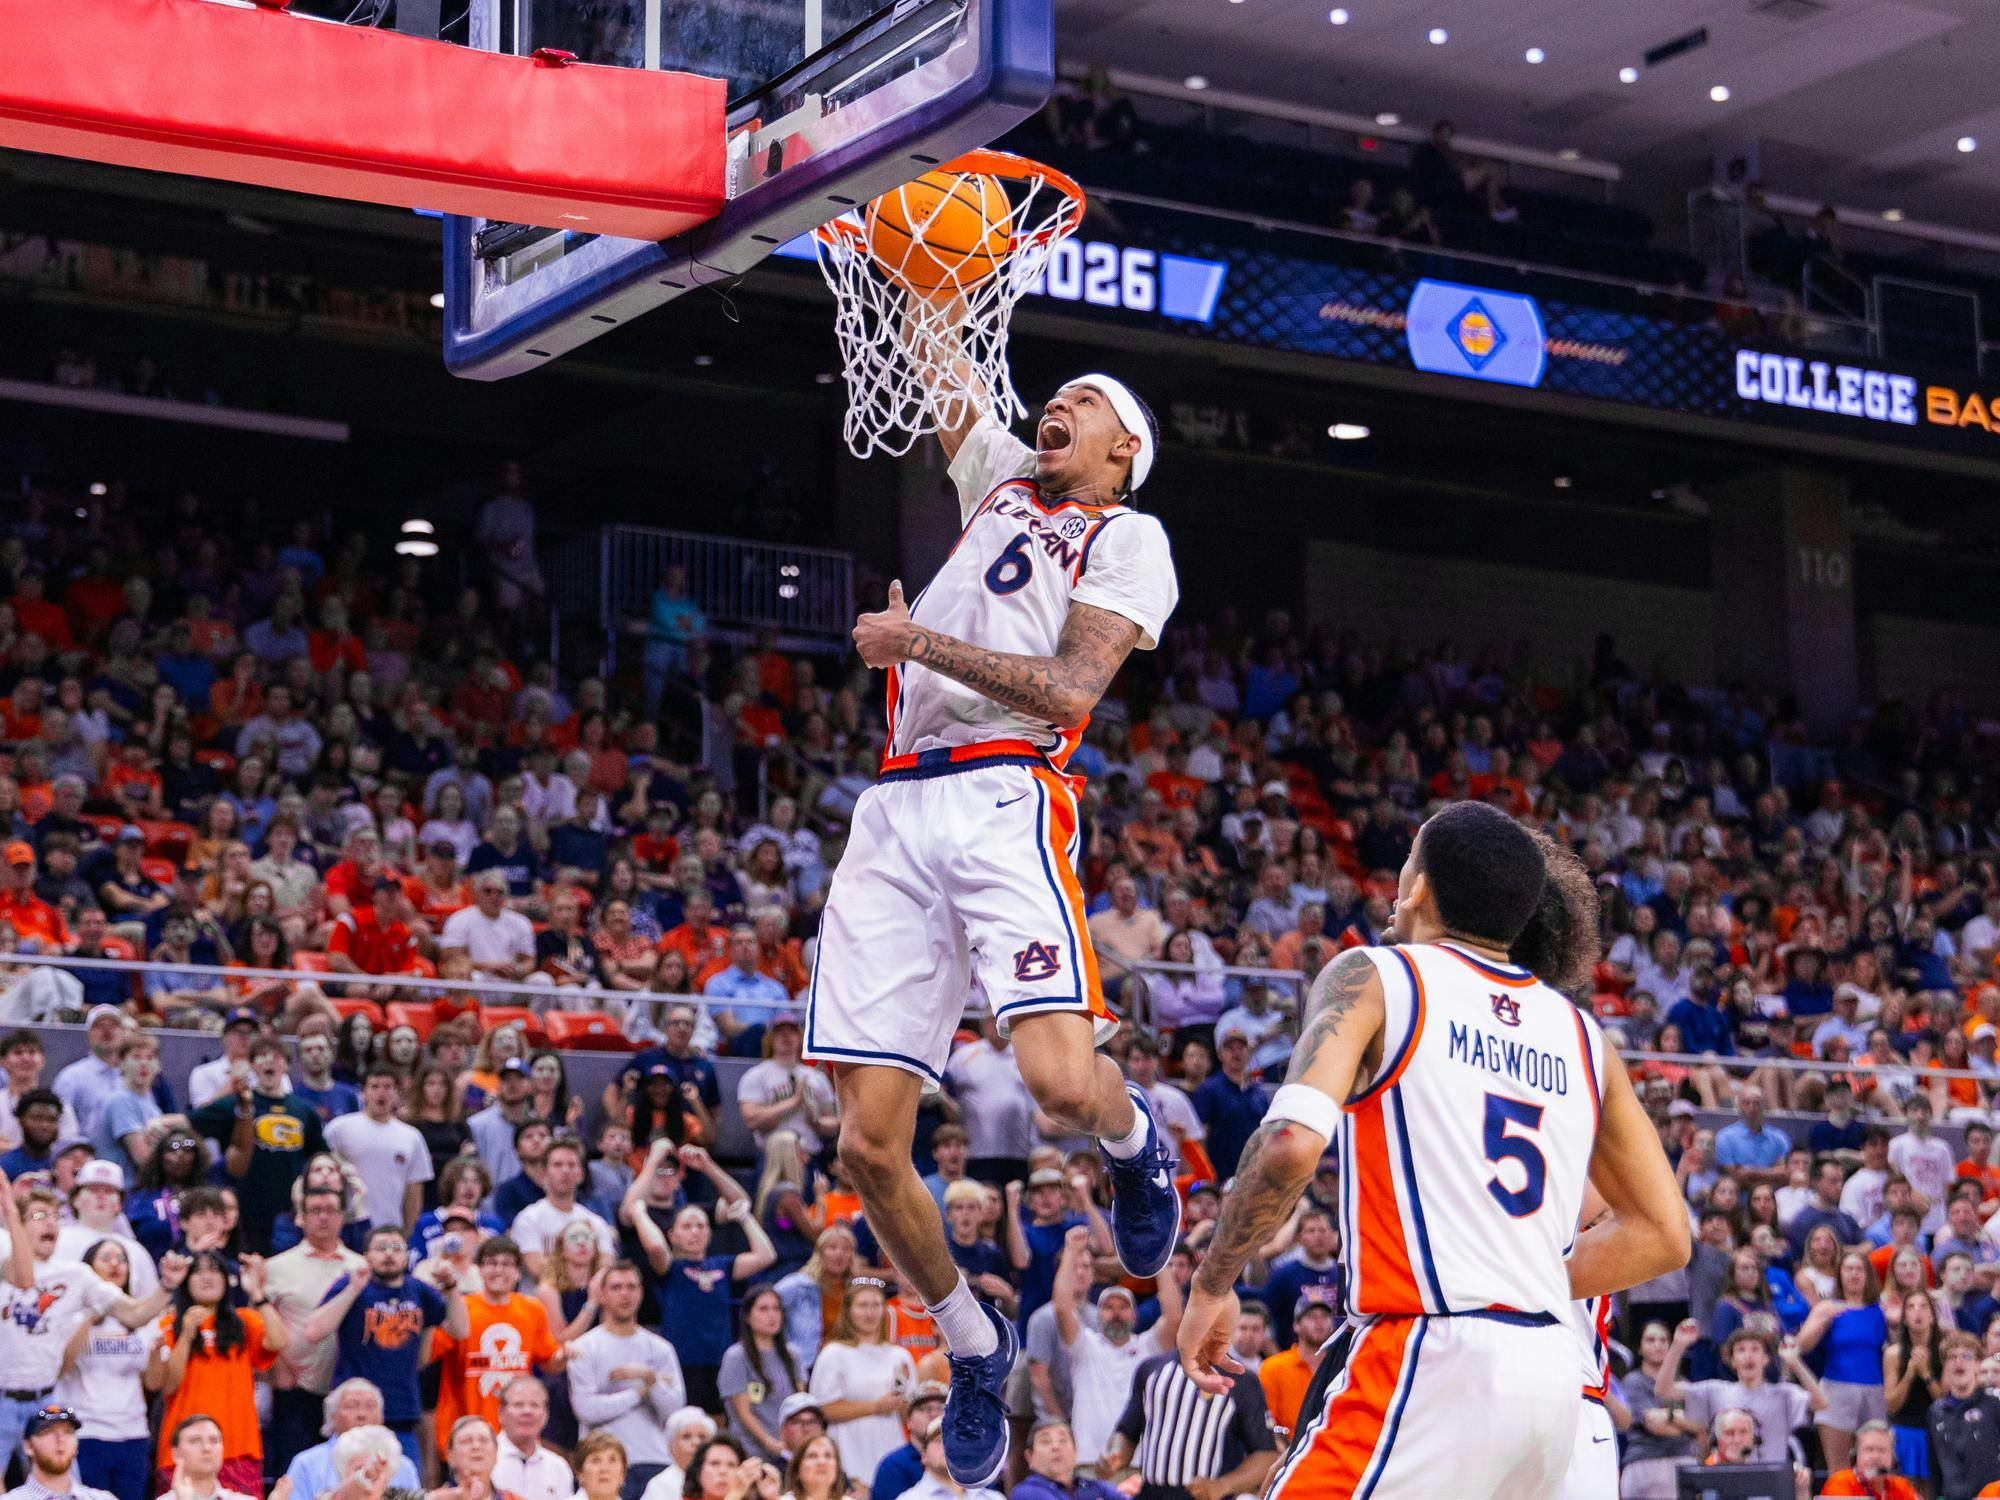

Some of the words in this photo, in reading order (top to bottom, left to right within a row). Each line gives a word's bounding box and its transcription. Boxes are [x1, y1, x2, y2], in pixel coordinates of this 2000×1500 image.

[1736, 349, 1918, 426] COLLEGE
[984, 531, 1033, 596] 6
[1448, 1020, 1567, 1096] MAGWOOD
[1483, 1091, 1547, 1219] 5
